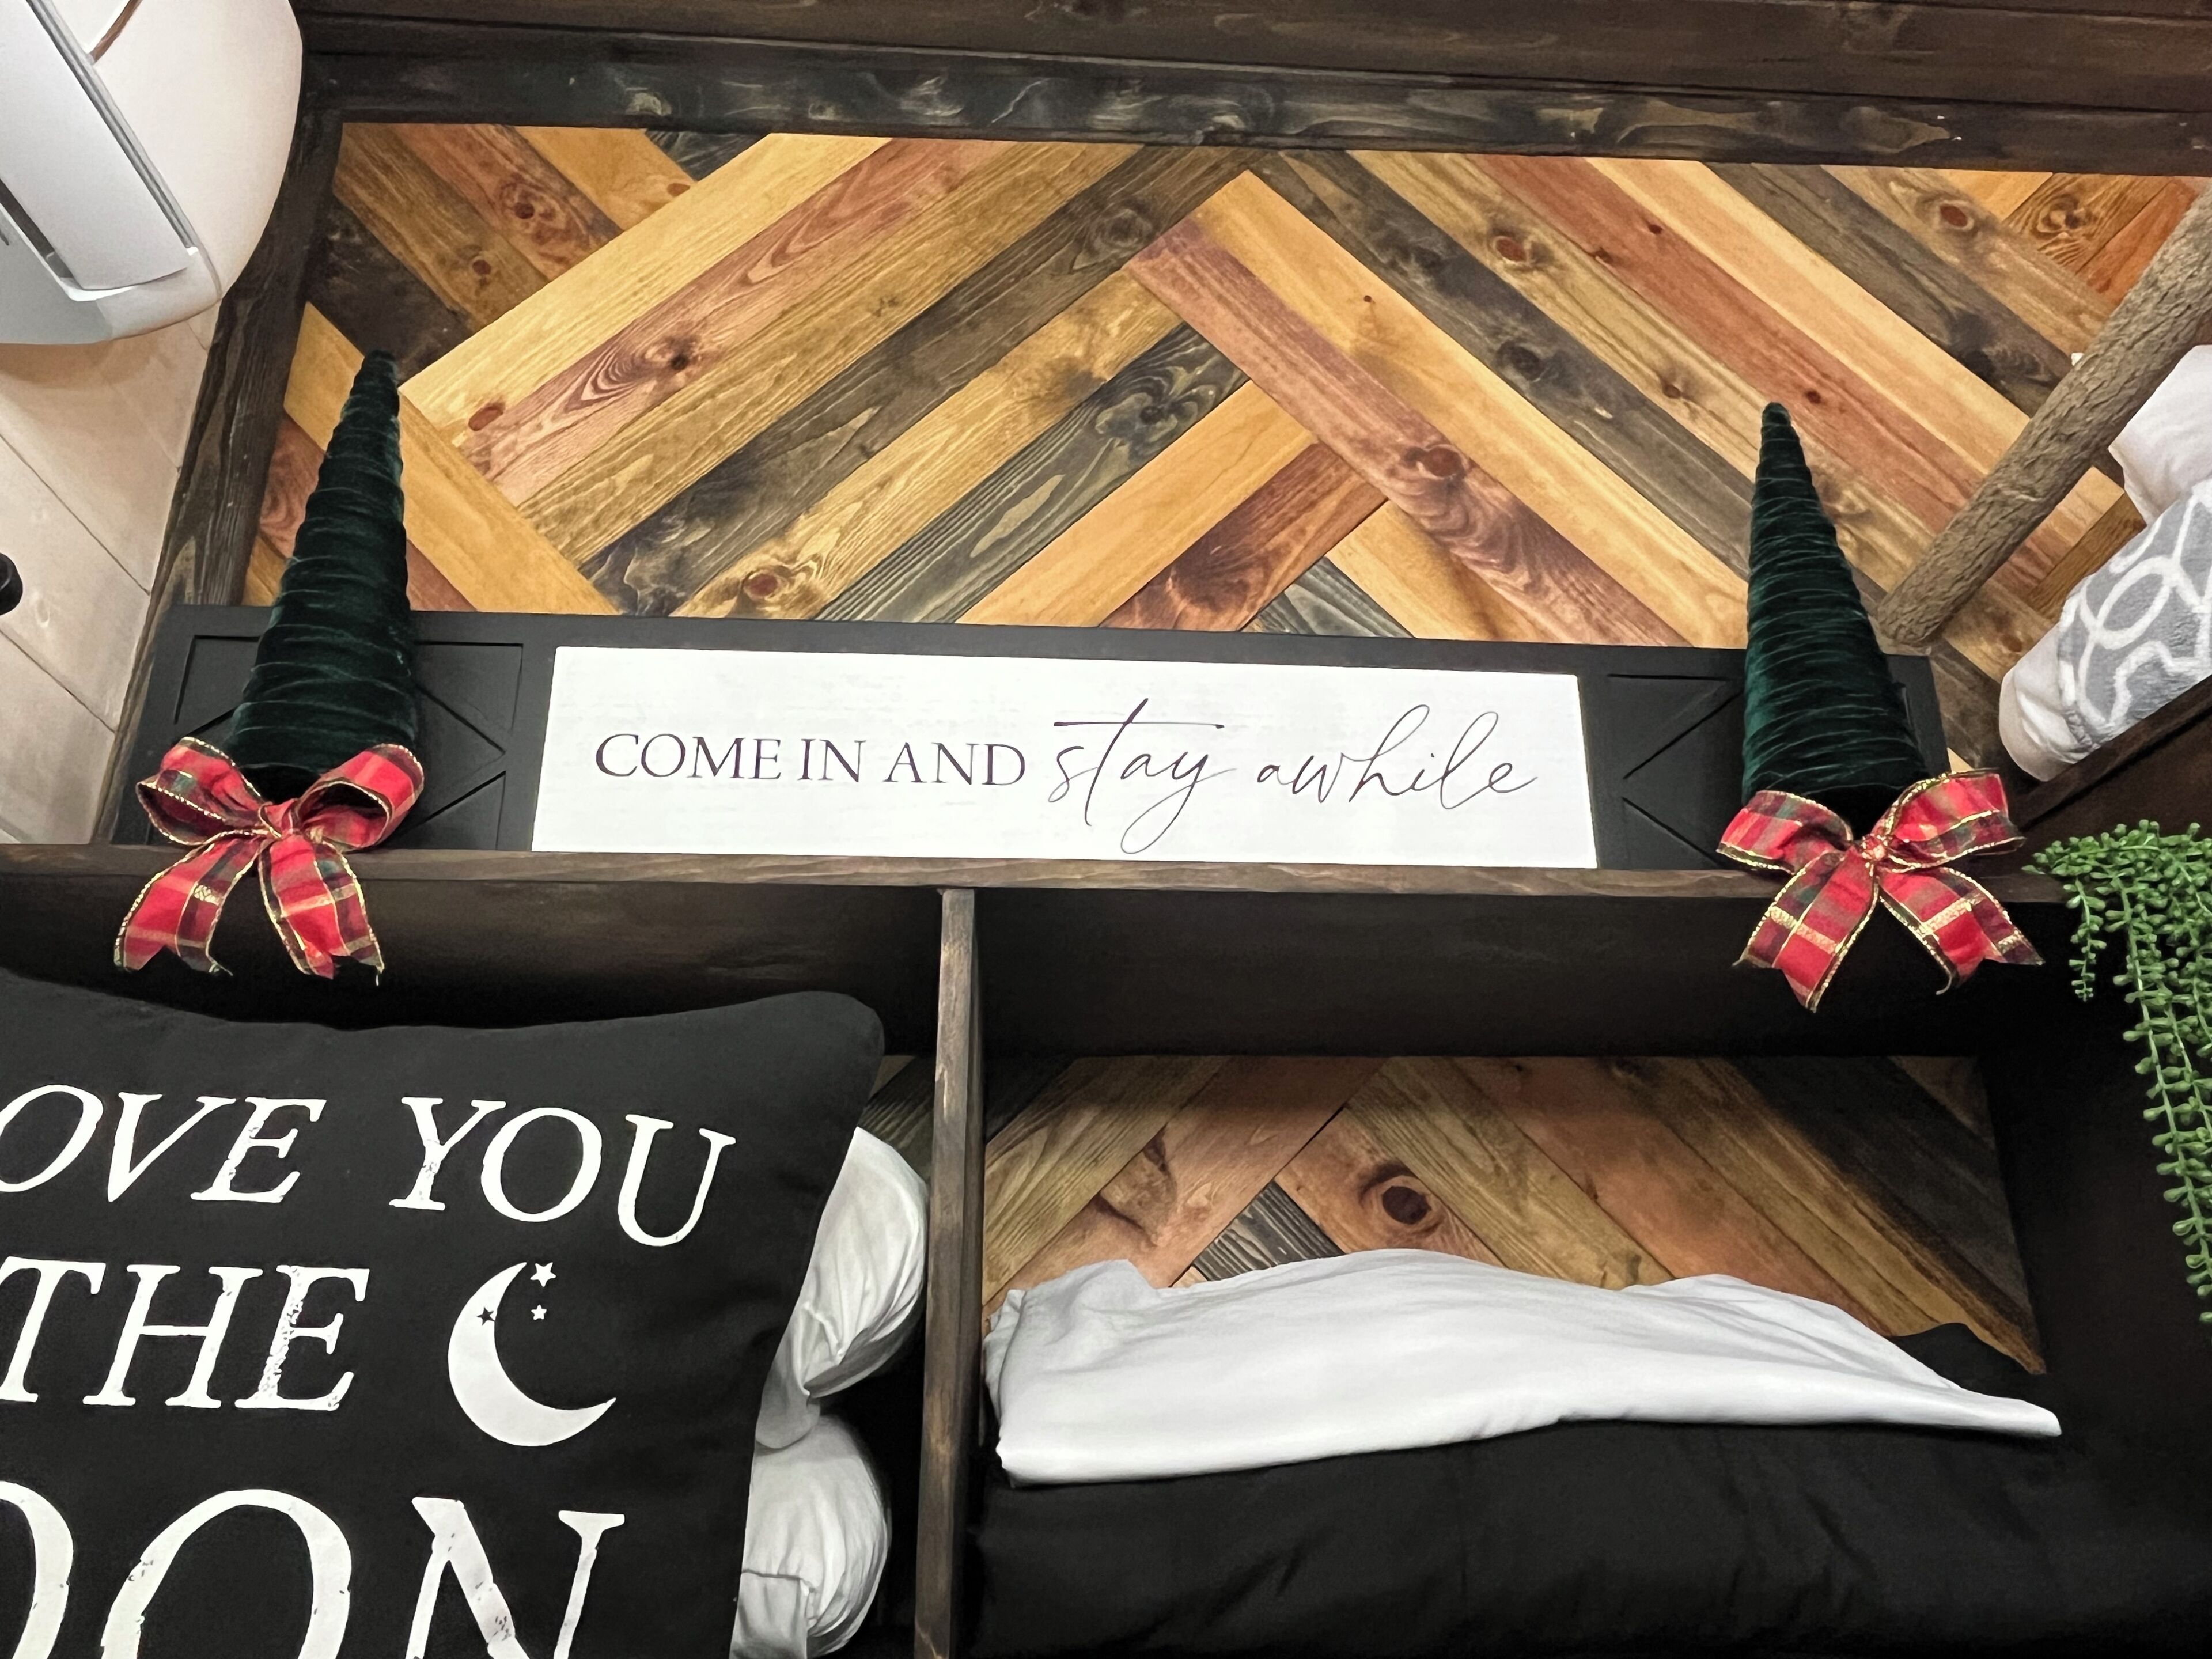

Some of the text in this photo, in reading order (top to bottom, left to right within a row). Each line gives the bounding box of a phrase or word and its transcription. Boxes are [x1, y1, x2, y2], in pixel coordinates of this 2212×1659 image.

[595, 698, 1539, 854] COME IN AND stay awhile
[388, 1096, 737, 1247] YOU
[0, 1255, 370, 1411] THE
